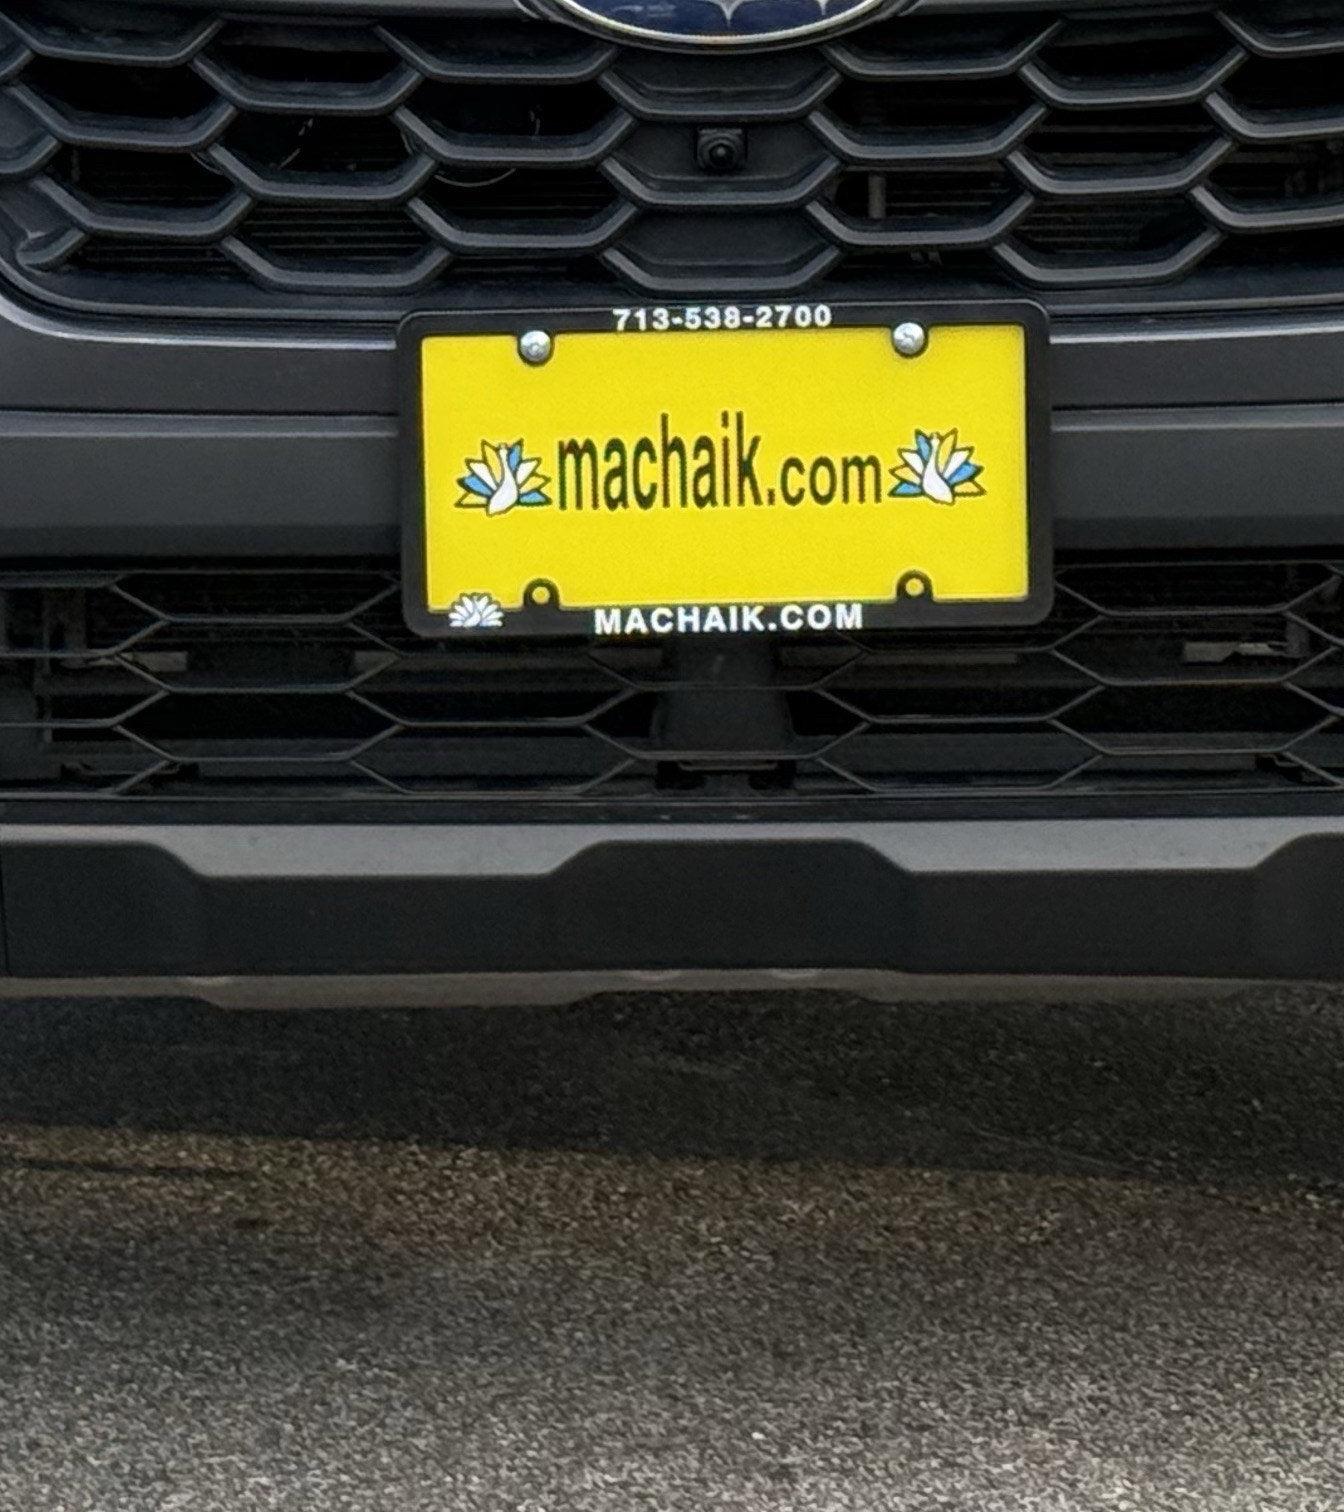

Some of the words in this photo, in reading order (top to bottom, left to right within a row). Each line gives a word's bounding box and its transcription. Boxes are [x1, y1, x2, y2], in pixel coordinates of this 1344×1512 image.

[612, 304, 832, 331] 713-538-2700
[558, 410, 883, 511] machaik.com
[593, 603, 864, 636] MACHAIK.COM
